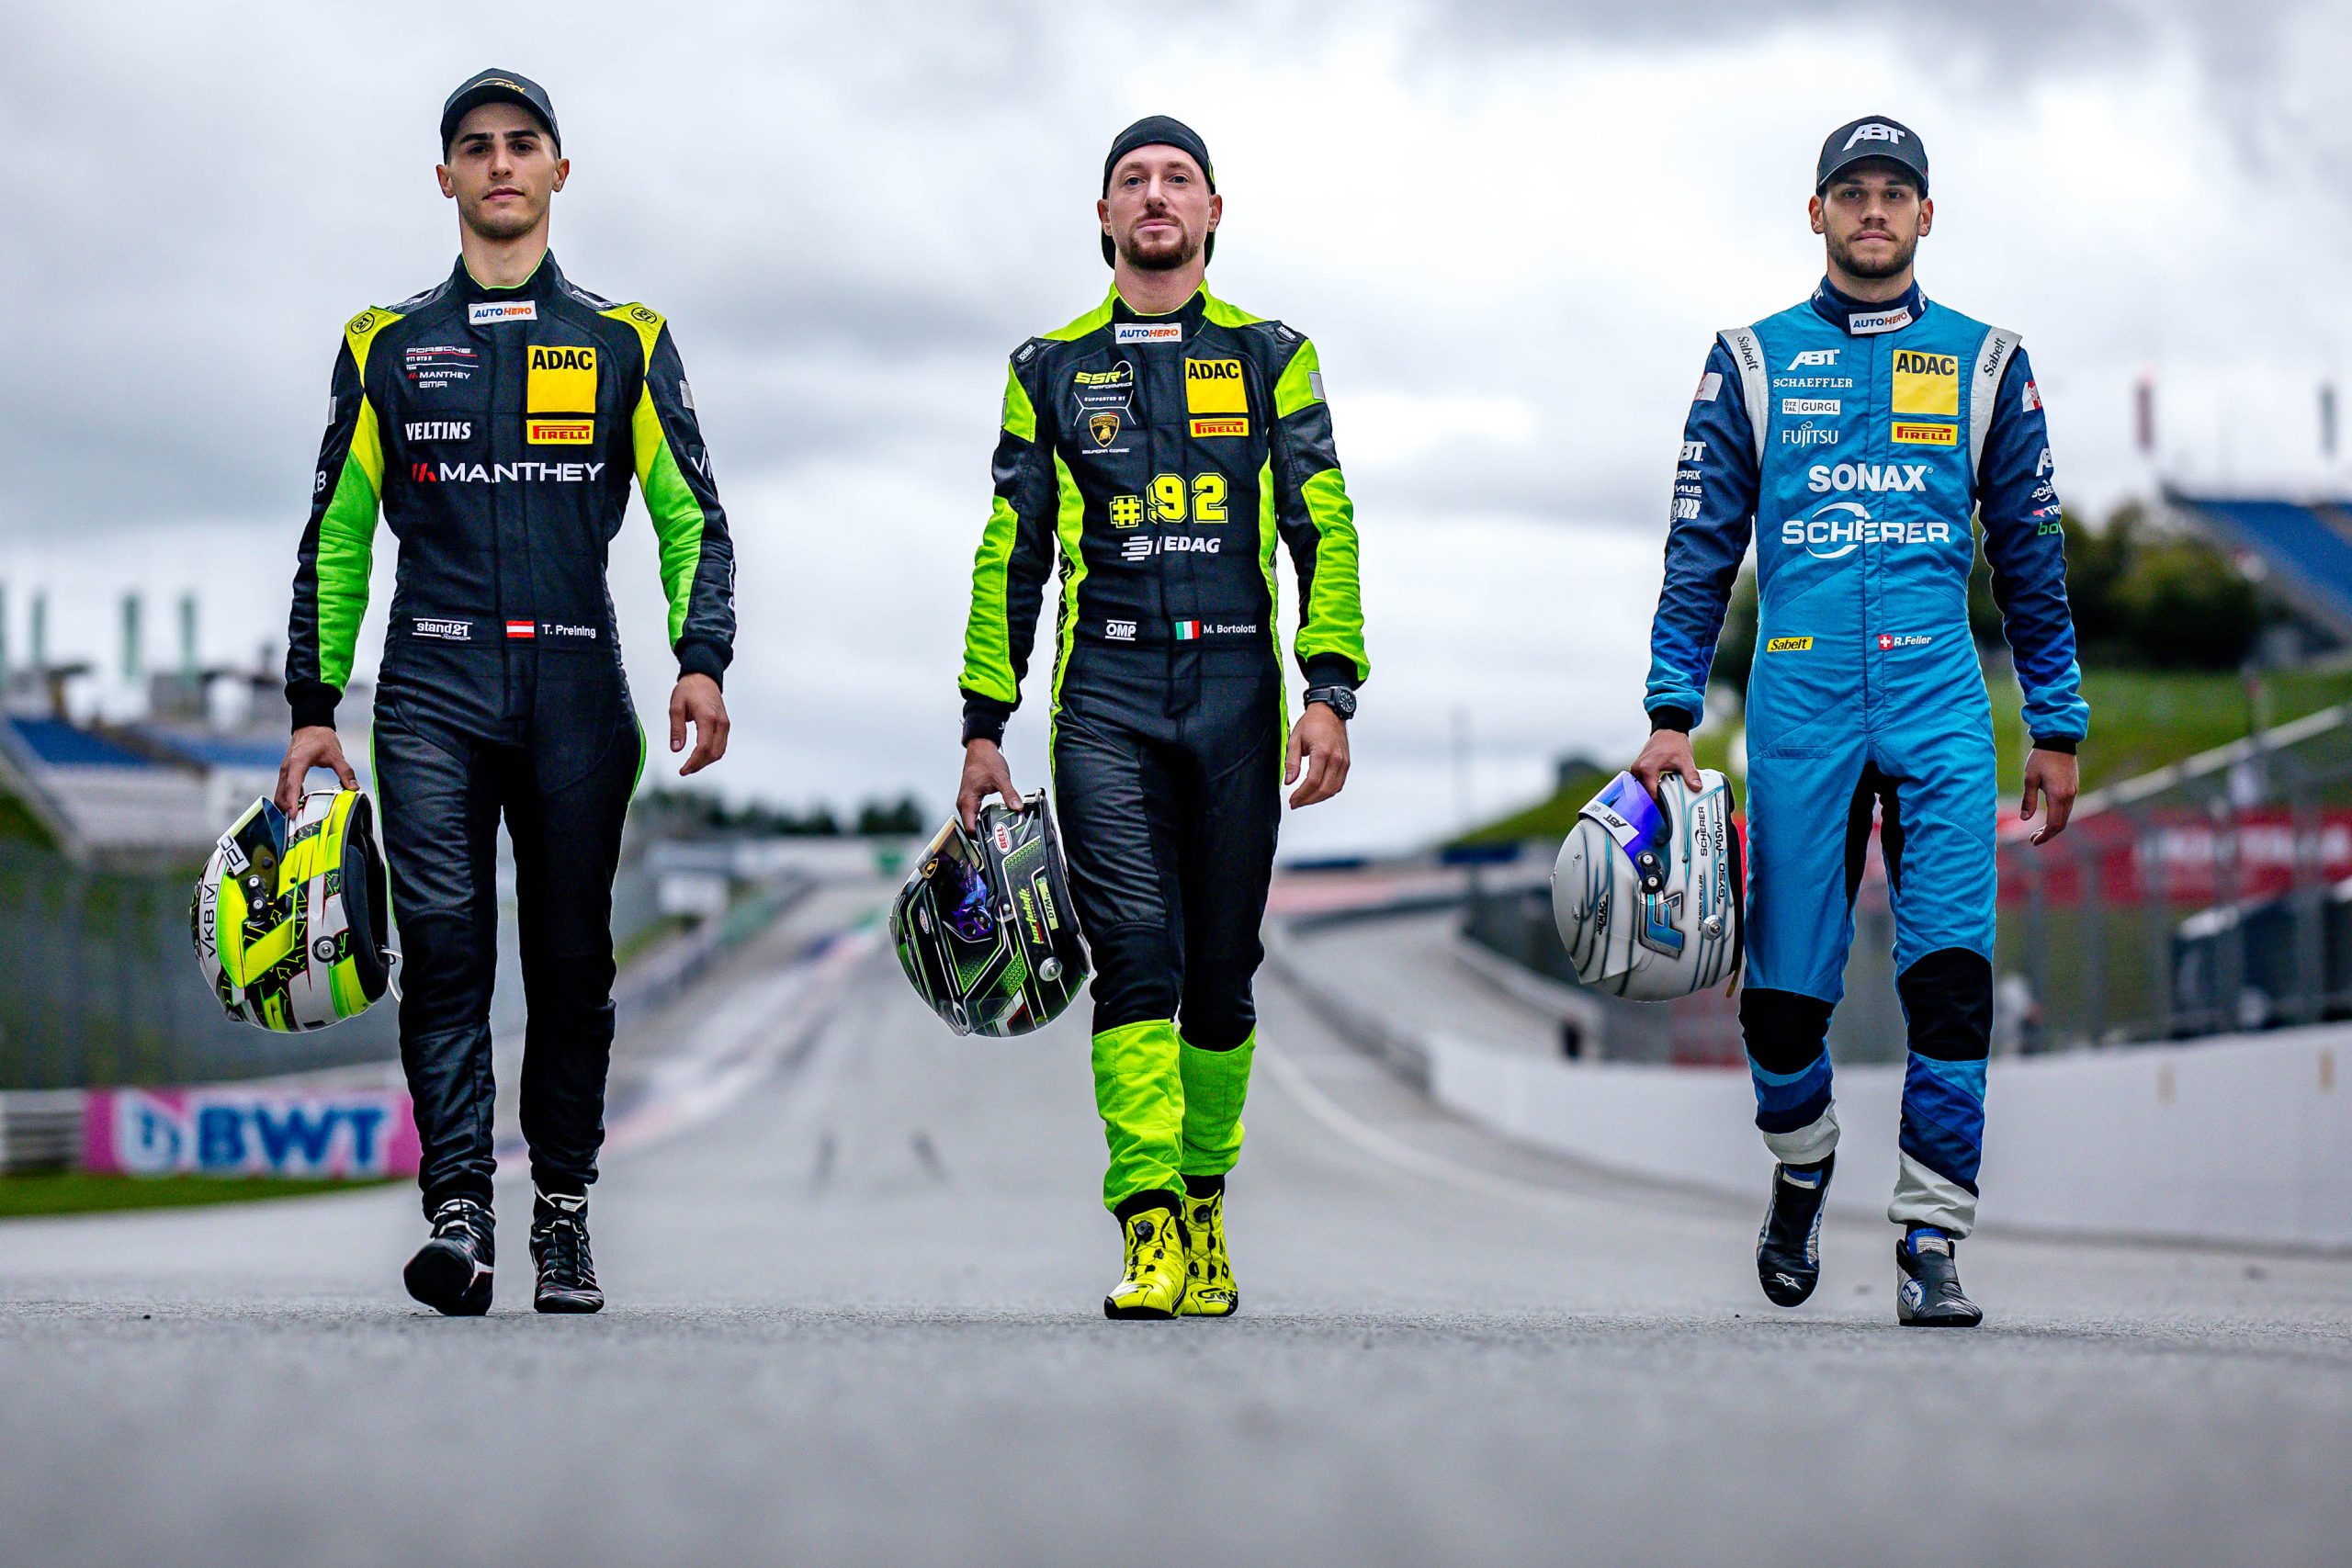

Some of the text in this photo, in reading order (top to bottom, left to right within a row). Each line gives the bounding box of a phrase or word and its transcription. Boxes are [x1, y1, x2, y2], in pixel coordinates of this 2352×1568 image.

[1842, 122, 1905, 151] ABT
[474, 306, 532, 319] AUTOHERO
[1852, 311, 1908, 328] AUTOHERO
[1119, 328, 1179, 339] AUTOHERO
[406, 345, 471, 355] PORSCHE
[1737, 336, 1759, 371] Sabelt
[1984, 336, 2007, 377] Sabelt
[532, 349, 594, 371] ADAC
[1786, 349, 1840, 371] ABT
[1895, 353, 1955, 376] ADAC
[419, 371, 471, 379] MANTHEY
[1074, 371, 1121, 385] SSR
[1188, 362, 1239, 379] ADAC
[1773, 378, 1853, 388] SCHAEFFLER
[1801, 402, 1838, 412] GURGL
[405, 422, 471, 441] VELTINS
[533, 425, 591, 439] PIRELLI
[1195, 422, 1244, 434] PIRELLI
[1896, 425, 1952, 441] PIRELLI
[1782, 427, 1839, 448] FUJITSU
[1679, 441, 1707, 461] BT
[439, 462, 605, 483] MANTHEY
[1807, 463, 1928, 492] SONAX
[1781, 520, 1951, 545] SCHERER
[1164, 536, 1221, 554] EDAG
[416, 621, 469, 637] stand21
[542, 624, 596, 638] T. Preining
[1105, 622, 1136, 638] OMP
[1204, 624, 1257, 634] M. Bortolotti
[1770, 638, 1808, 650] Sabelt
[997, 826, 1008, 849] BELL
[1698, 806, 1708, 856] SCHERER
[201, 908, 217, 959] VKB
[198, 1107, 383, 1168] BWT
